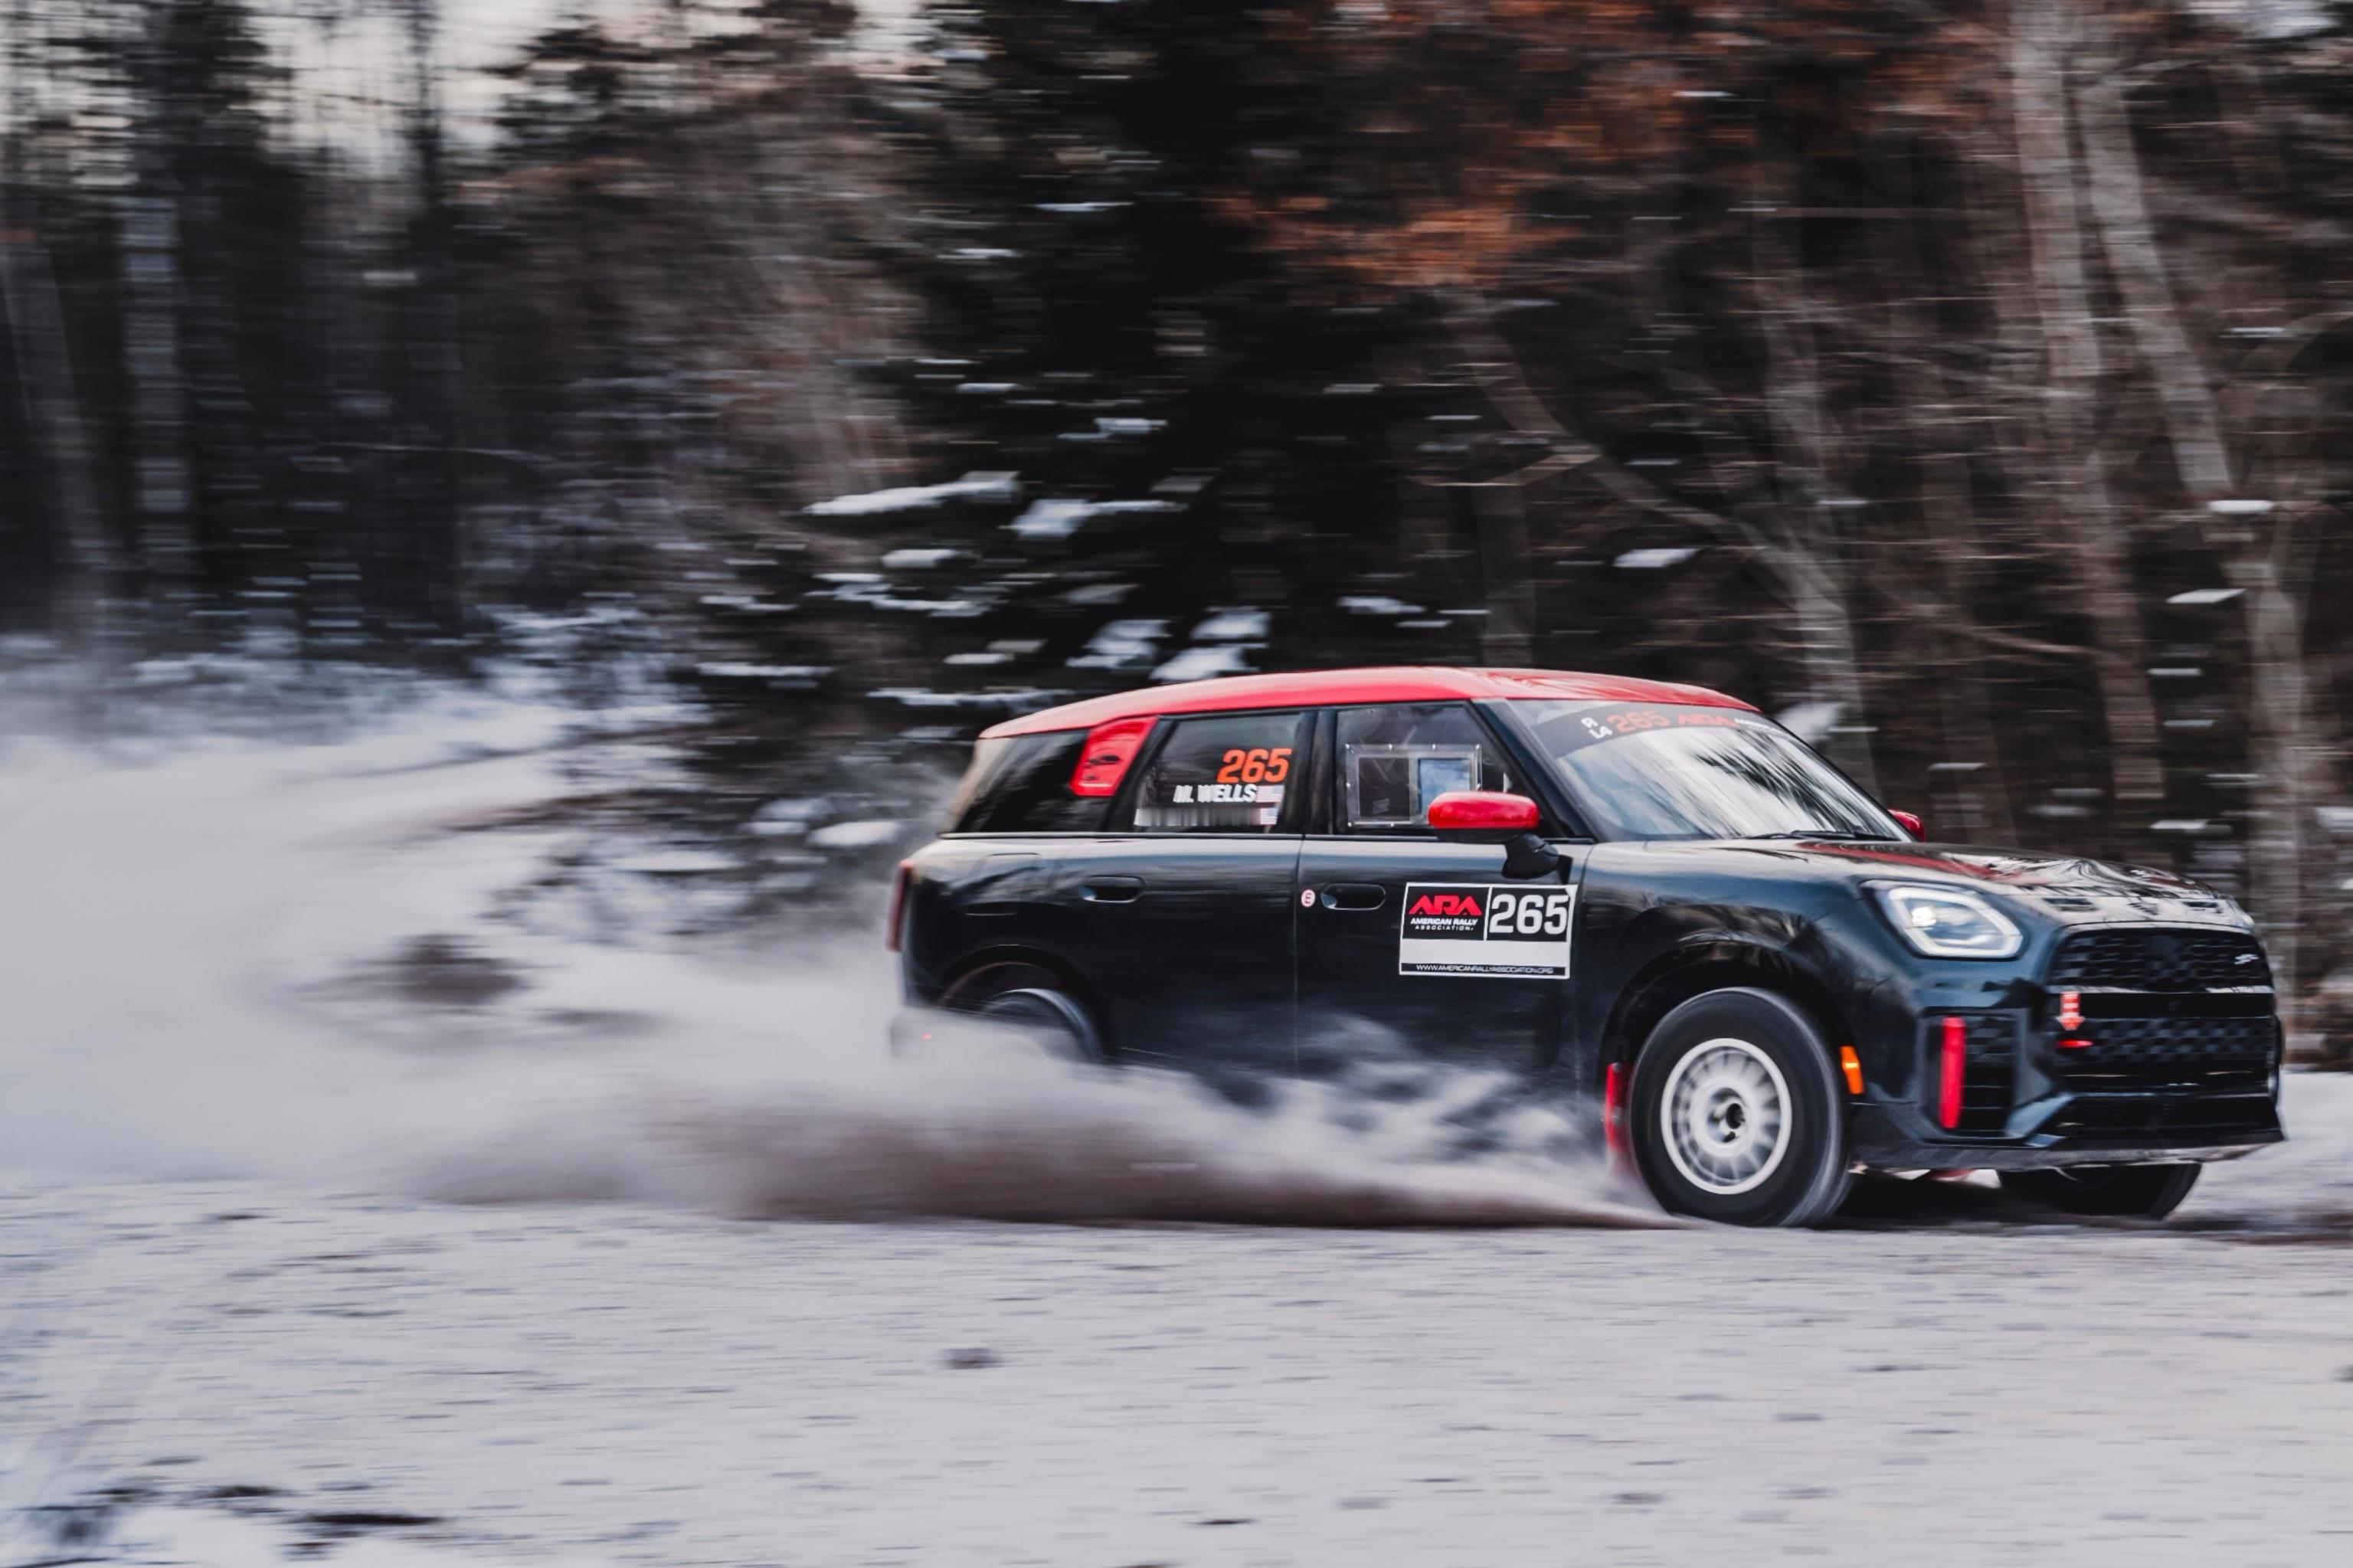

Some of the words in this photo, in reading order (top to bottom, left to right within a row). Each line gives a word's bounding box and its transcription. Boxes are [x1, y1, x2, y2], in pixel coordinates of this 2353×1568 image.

[1607, 710, 1671, 733] 265
[1216, 748, 1293, 783] 265
[1173, 784, 1194, 803] M.
[1197, 784, 1258, 803] WELLS
[1409, 895, 1483, 915] ARA
[1489, 893, 1569, 935] 265
[1453, 918, 1478, 926] RALLY
